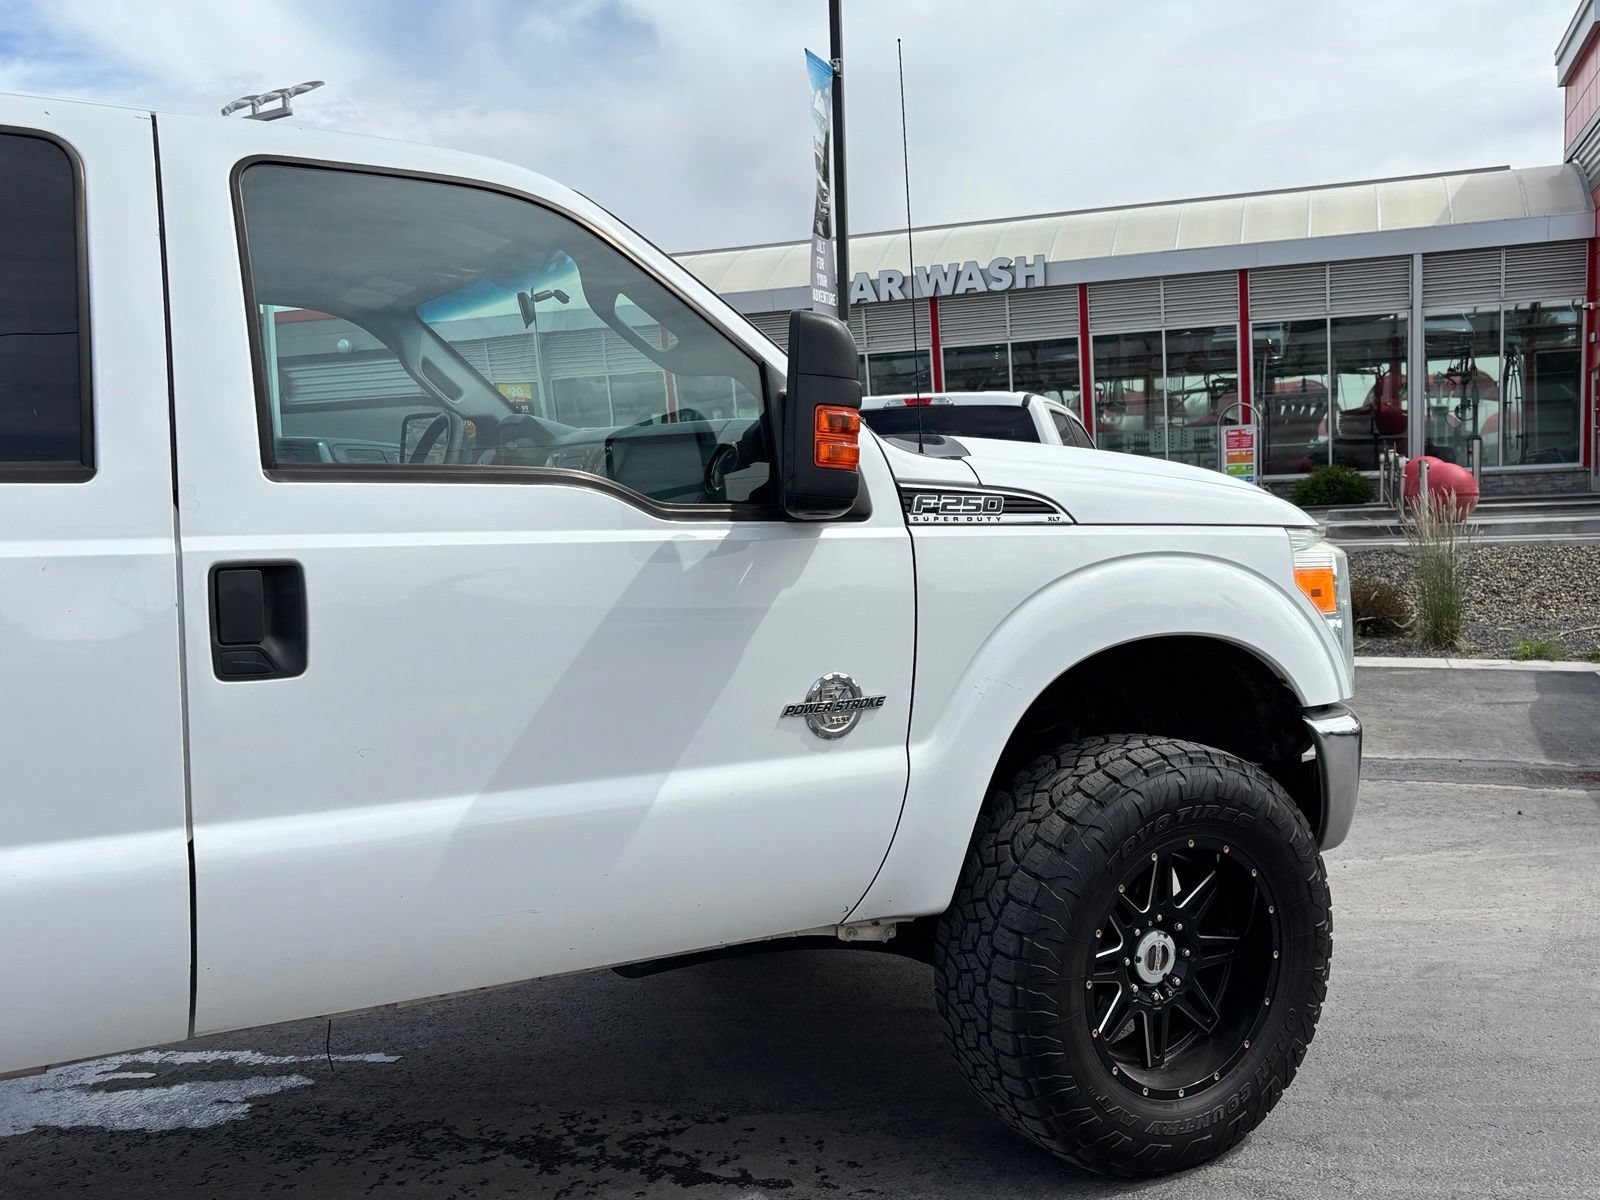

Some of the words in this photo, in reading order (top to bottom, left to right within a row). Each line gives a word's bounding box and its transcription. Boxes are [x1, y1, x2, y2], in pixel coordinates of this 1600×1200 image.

[816, 256, 825, 270] FOR
[850, 272, 907, 304] AR
[914, 254, 1045, 297] WASH
[911, 494, 1005, 515] F-250
[783, 700, 834, 716] POWER
[834, 695, 886, 712] STROKE
[1176, 804, 1256, 828] TIRES
[1096, 1095, 1141, 1127] A/T
[1144, 1082, 1252, 1136] COUNTRY
